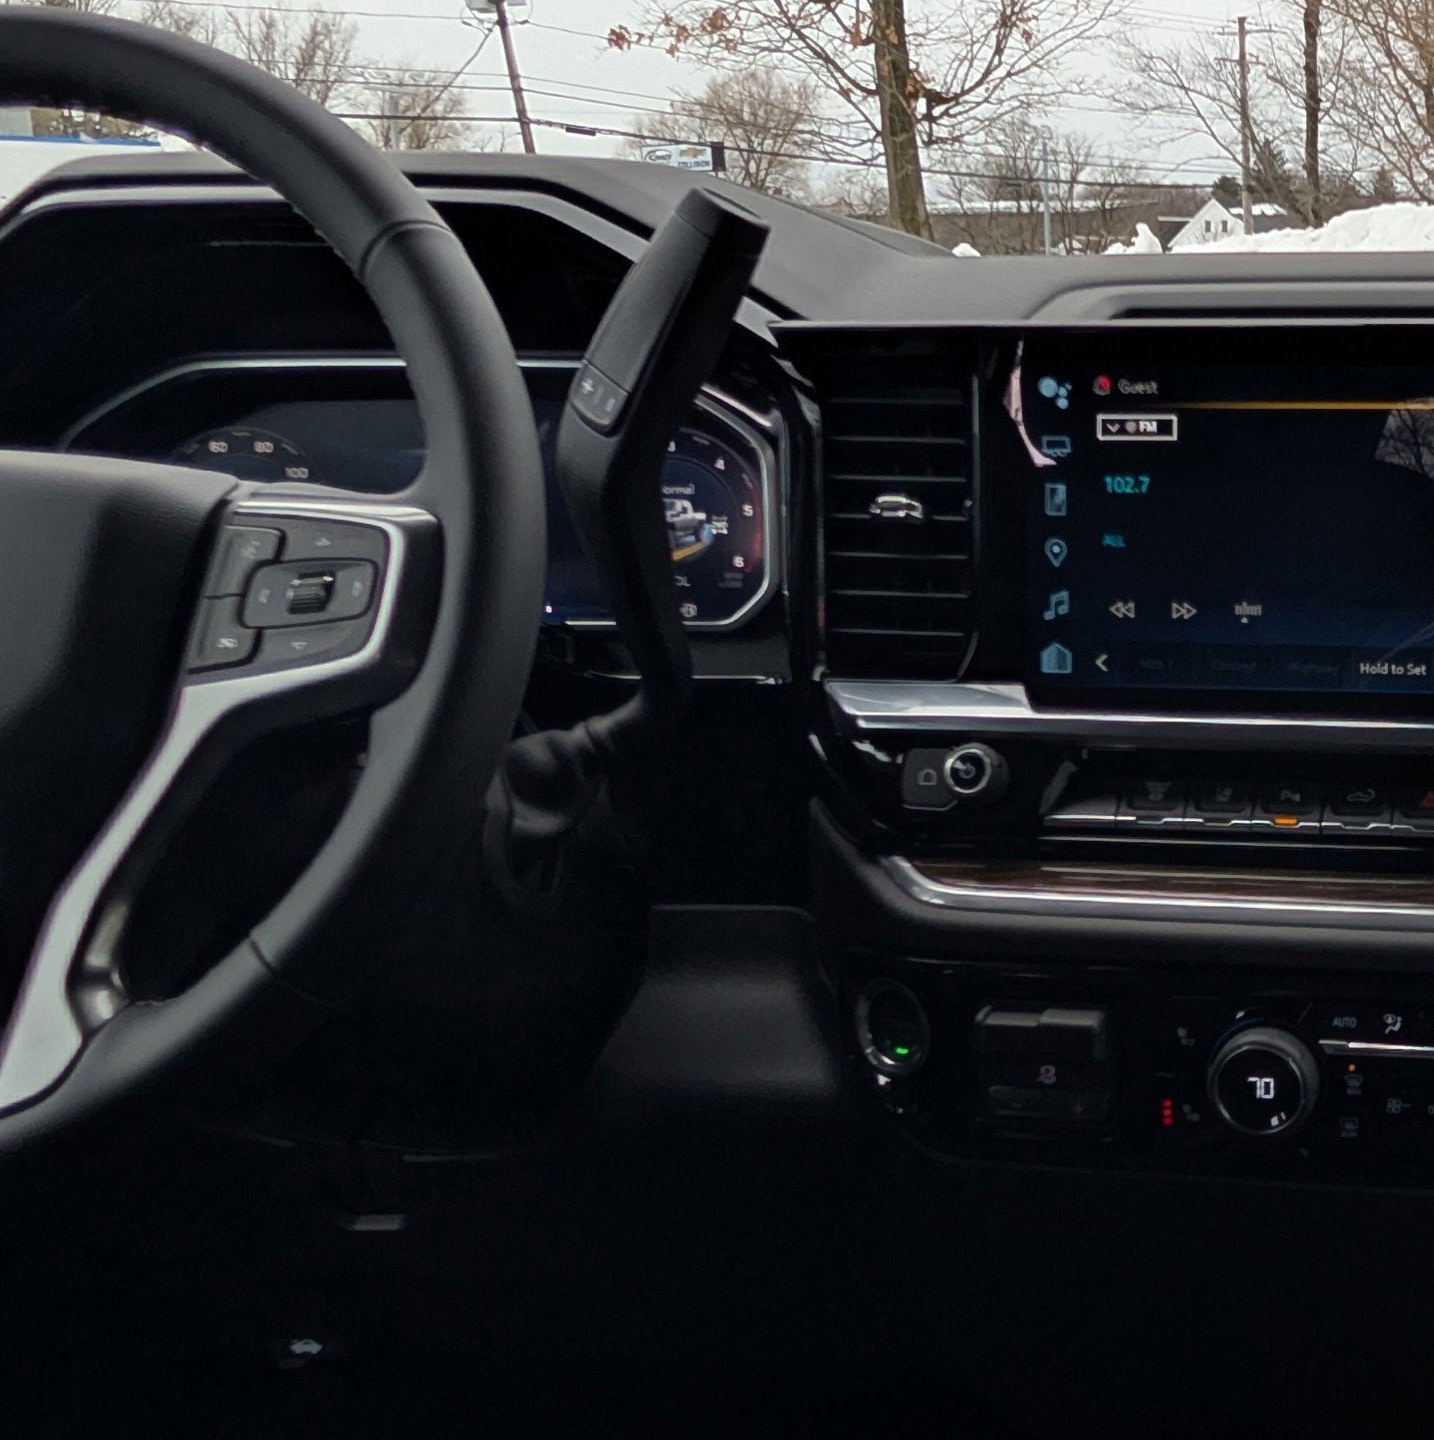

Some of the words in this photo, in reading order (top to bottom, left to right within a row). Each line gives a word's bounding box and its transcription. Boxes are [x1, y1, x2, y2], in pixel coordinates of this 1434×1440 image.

[1118, 380, 1159, 395] Guest
[1139, 421, 1158, 434] FM
[714, 457, 725, 470] 4
[662, 483, 696, 495] ormal
[1104, 475, 1150, 494] 102.7
[742, 504, 754, 517] 5
[1359, 662, 1388, 675] Hold
[1391, 664, 1404, 675] to
[1407, 663, 1427, 676] Set
[1332, 1017, 1358, 1028] AUTO
[1247, 1076, 1274, 1099] 70
